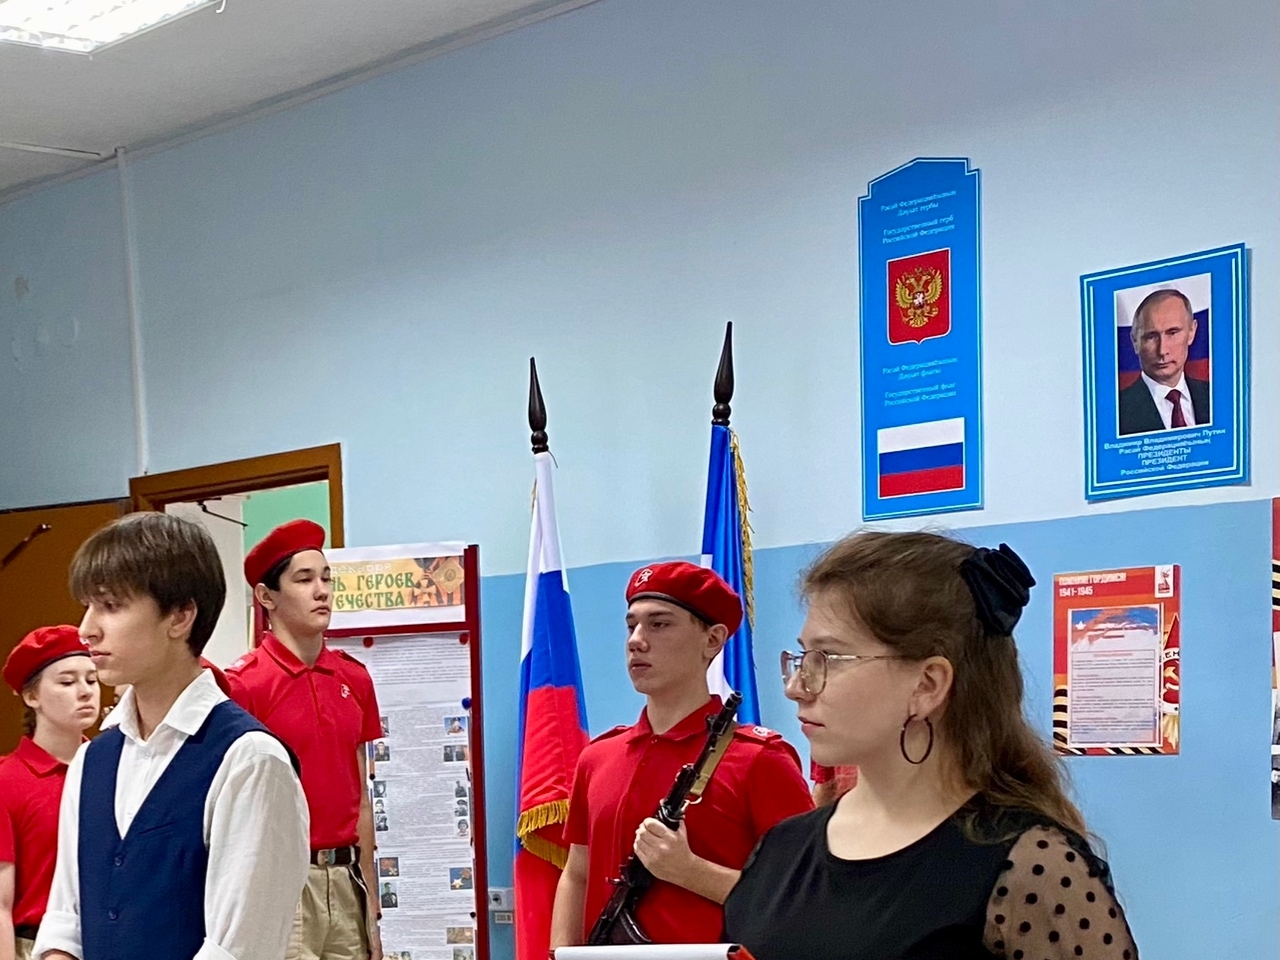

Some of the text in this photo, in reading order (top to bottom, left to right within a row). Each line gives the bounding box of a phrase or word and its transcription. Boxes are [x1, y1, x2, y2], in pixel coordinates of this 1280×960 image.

[1104, 429, 1226, 450] Владимир Владимирович Путин
[1137, 447, 1191, 460] ПРЕЗИДЕНТЫ
[1141, 454, 1188, 466] ПРЕЗИДЕНТ
[1166, 460, 1209, 470] Федерации
[357, 572, 415, 591] ГЕРОЕВ
[1058, 585, 1094, 598] 1941-1945
[333, 590, 405, 610] ЕЧЕСТВА
